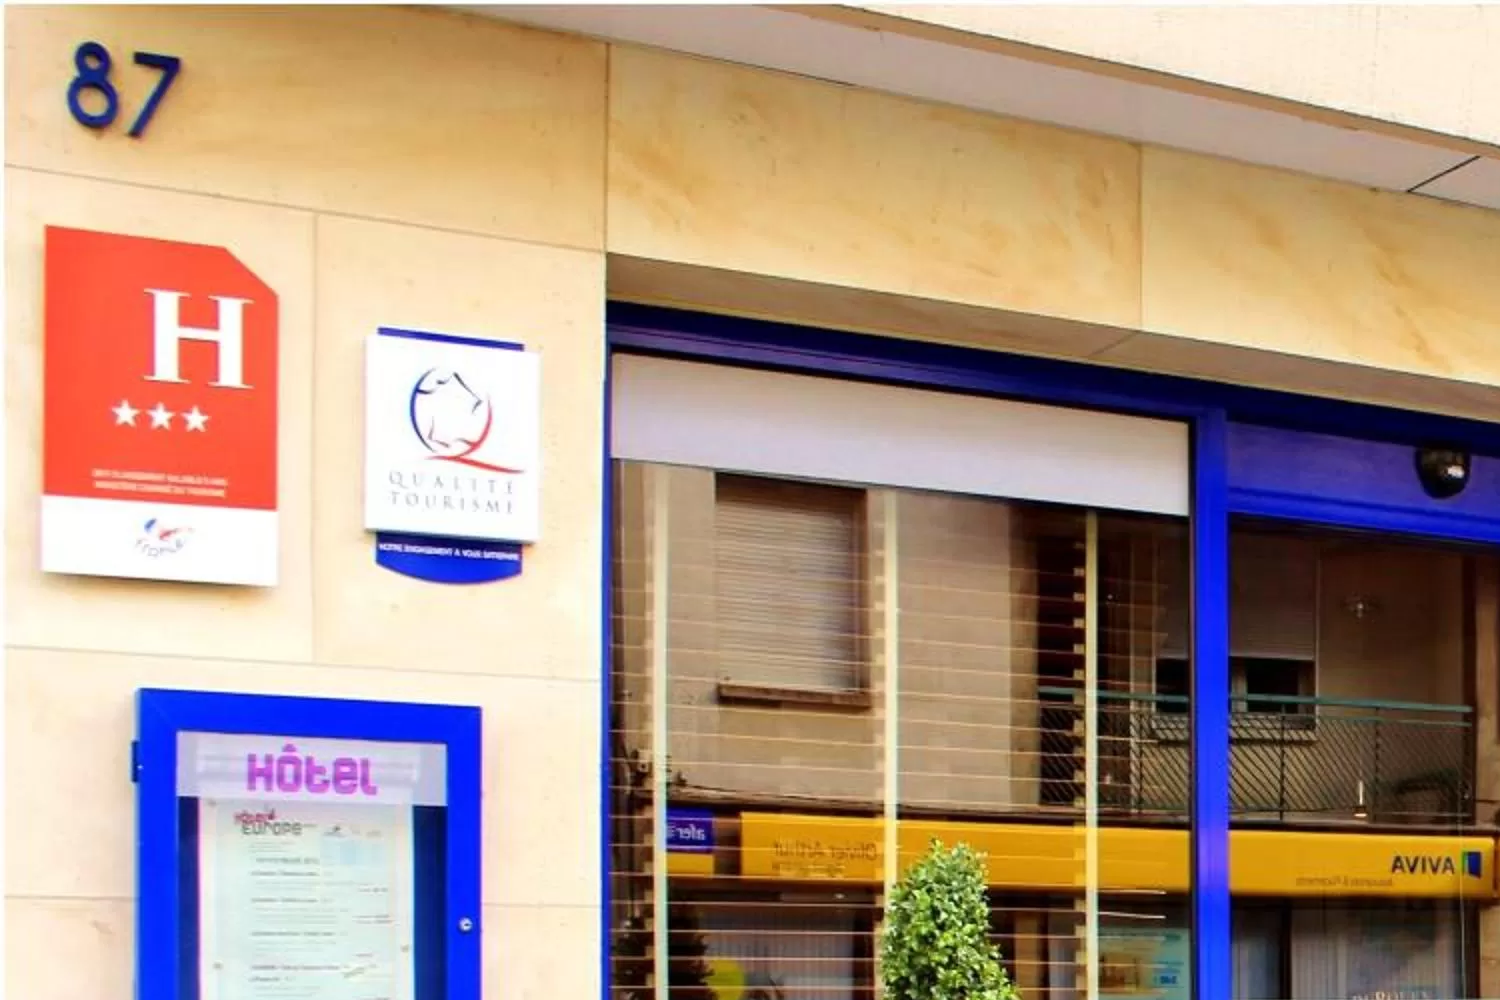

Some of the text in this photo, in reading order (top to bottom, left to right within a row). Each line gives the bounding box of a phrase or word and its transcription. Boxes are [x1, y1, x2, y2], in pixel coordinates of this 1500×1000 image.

[67, 41, 181, 138] 87
[143, 287, 254, 390] H
[389, 491, 513, 514] TOURISME
